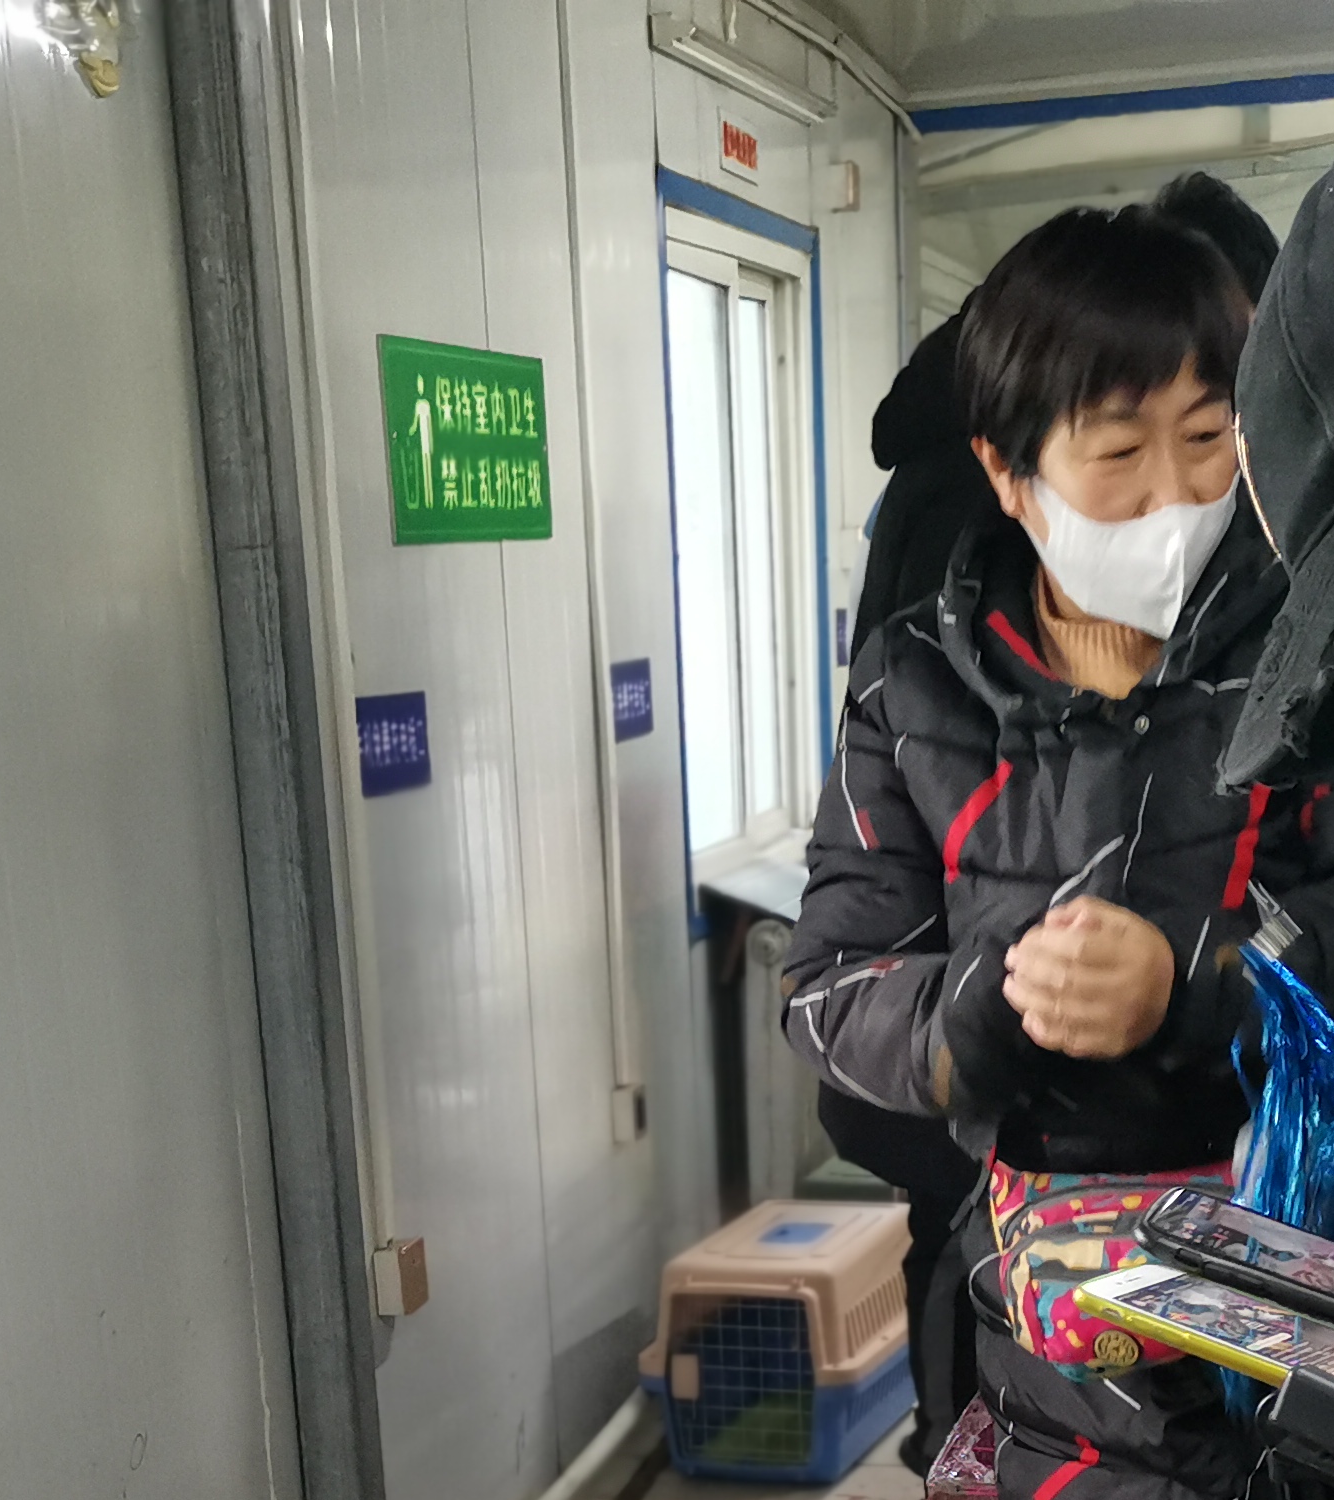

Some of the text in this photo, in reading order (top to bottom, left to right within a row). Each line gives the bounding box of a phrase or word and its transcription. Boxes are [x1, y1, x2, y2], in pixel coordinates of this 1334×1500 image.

[435, 374, 539, 438] 保持室内卫生
